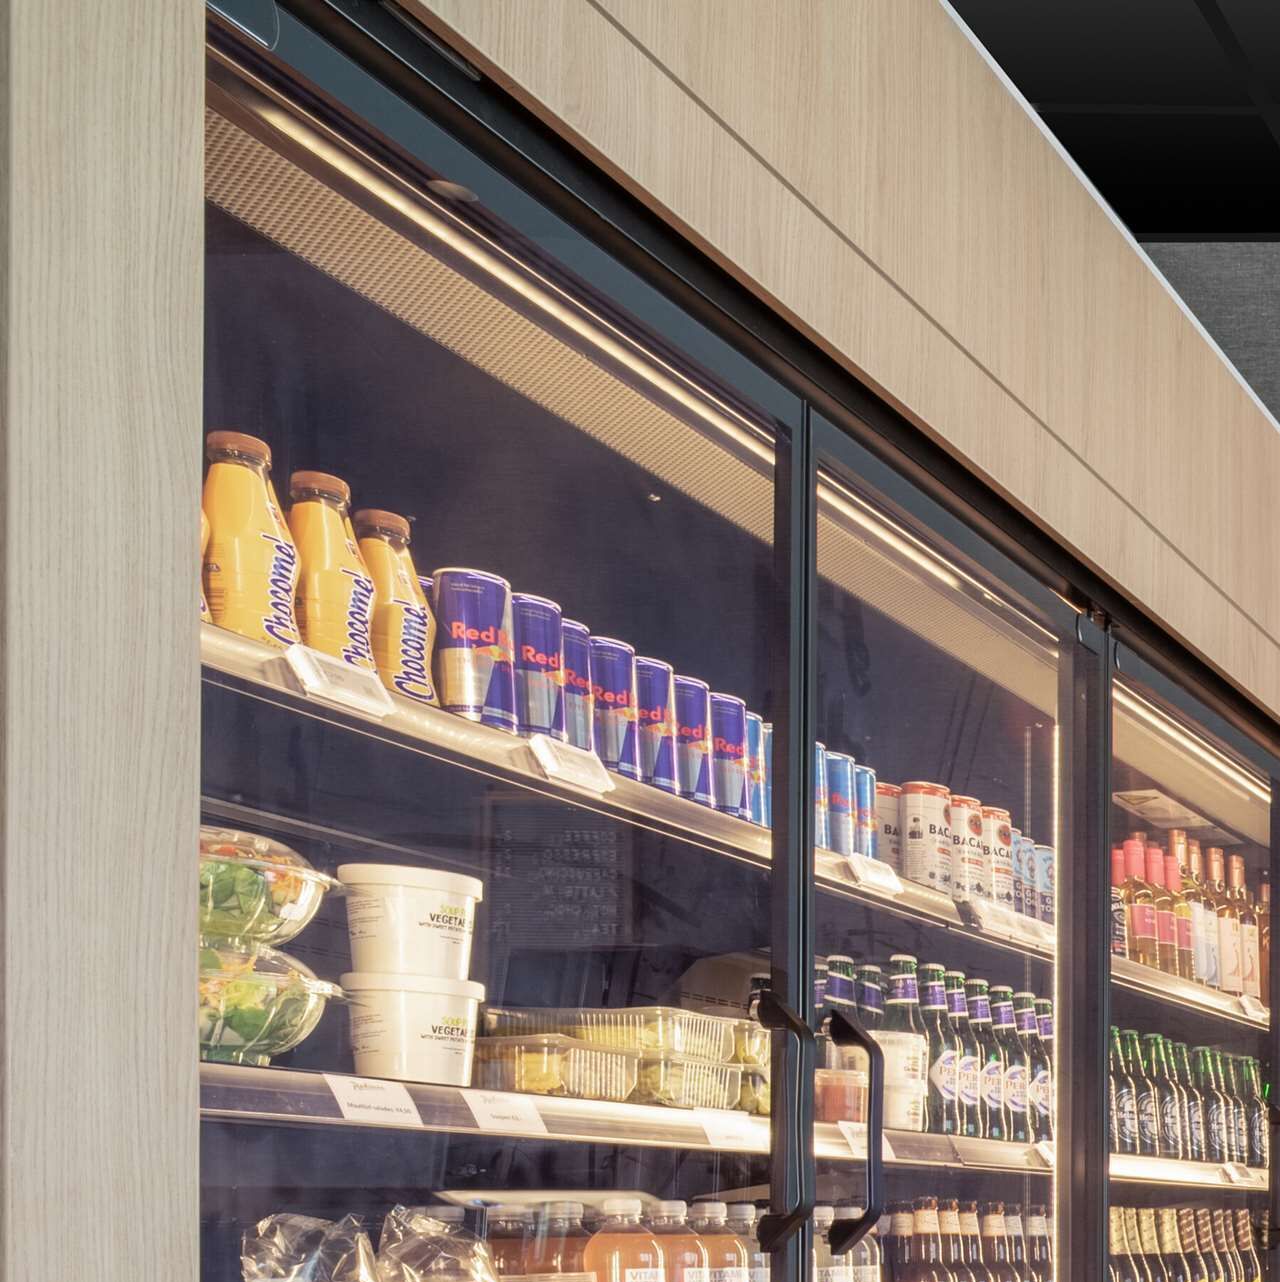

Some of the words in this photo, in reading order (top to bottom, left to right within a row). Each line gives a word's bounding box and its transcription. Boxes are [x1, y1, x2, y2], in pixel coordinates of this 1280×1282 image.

[451, 622, 495, 644] Red
[393, 600, 434, 700] Chocomel
[522, 646, 559, 667] Red
